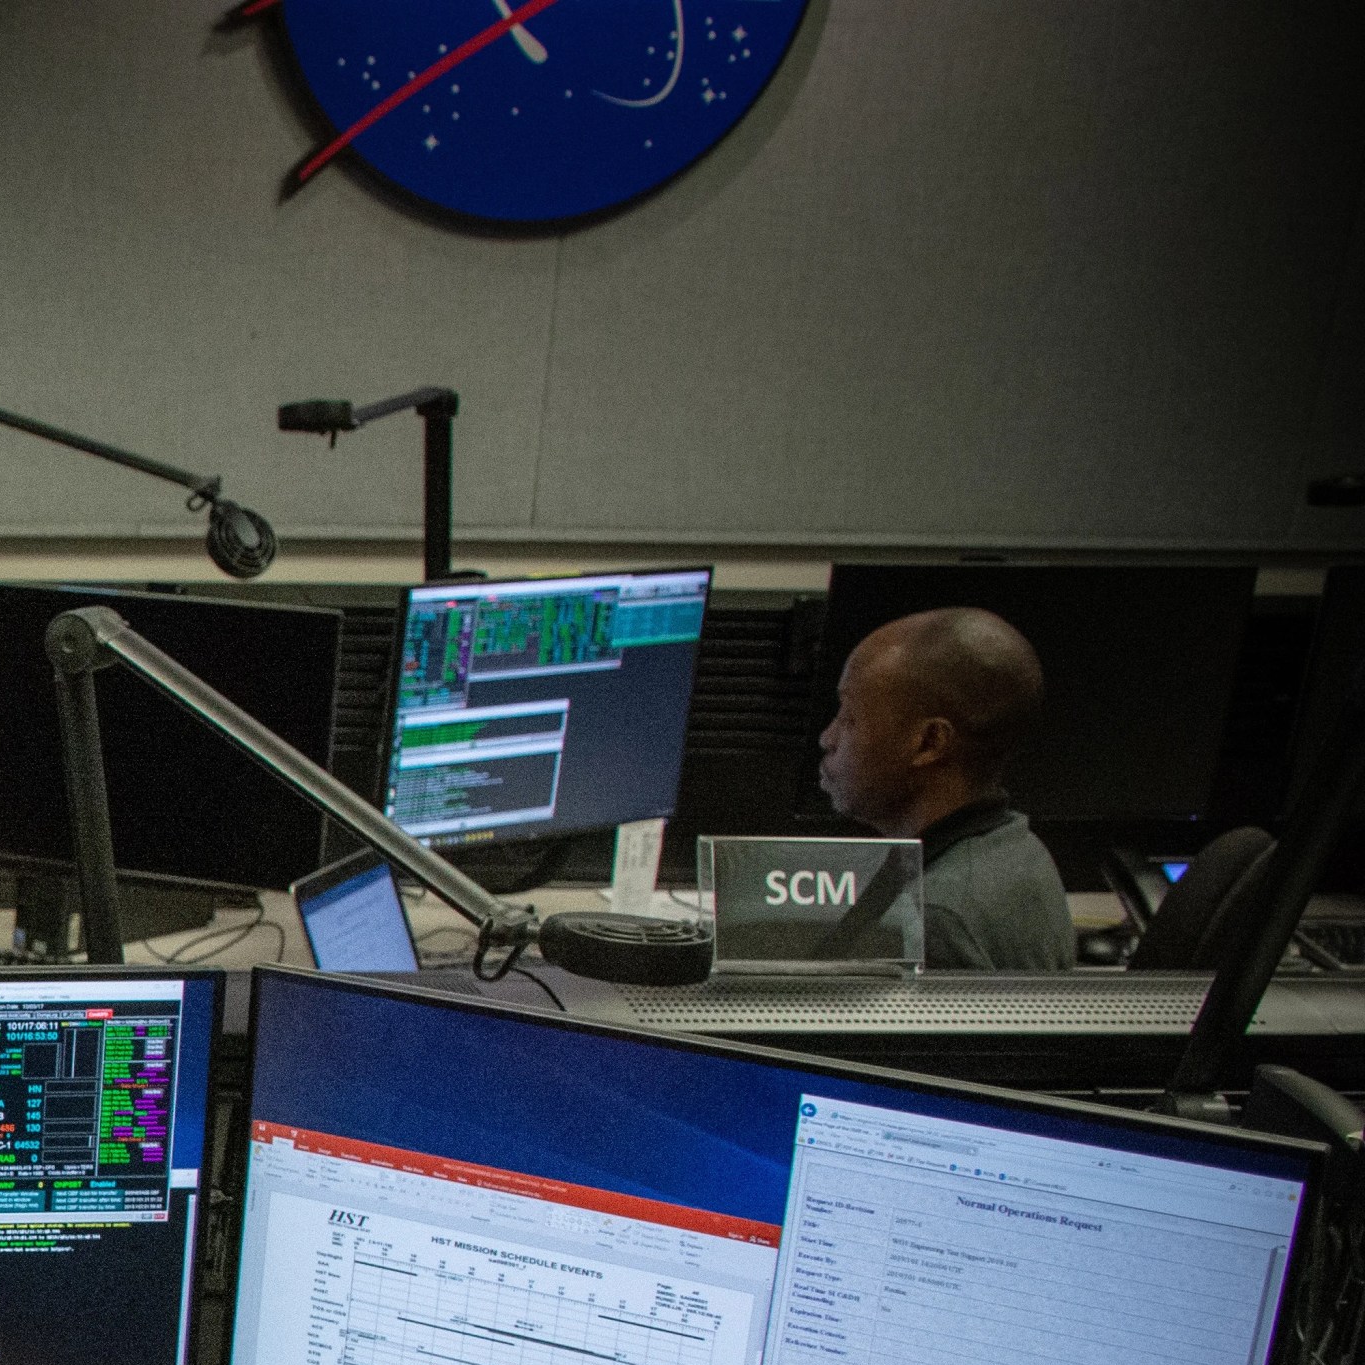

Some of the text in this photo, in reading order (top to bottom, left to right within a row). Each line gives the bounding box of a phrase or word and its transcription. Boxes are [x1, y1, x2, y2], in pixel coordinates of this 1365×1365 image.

[765, 870, 857, 907] SCM
[6, 1032, 58, 1040] 101/16:53:50
[7, 1022, 58, 1030] 101/17:06:11
[328, 1209, 369, 1227] HST
[956, 1196, 1103, 1232] Normal Operations Request
[431, 1236, 603, 1280] HST MISSION SCHEDULE EVENTS
